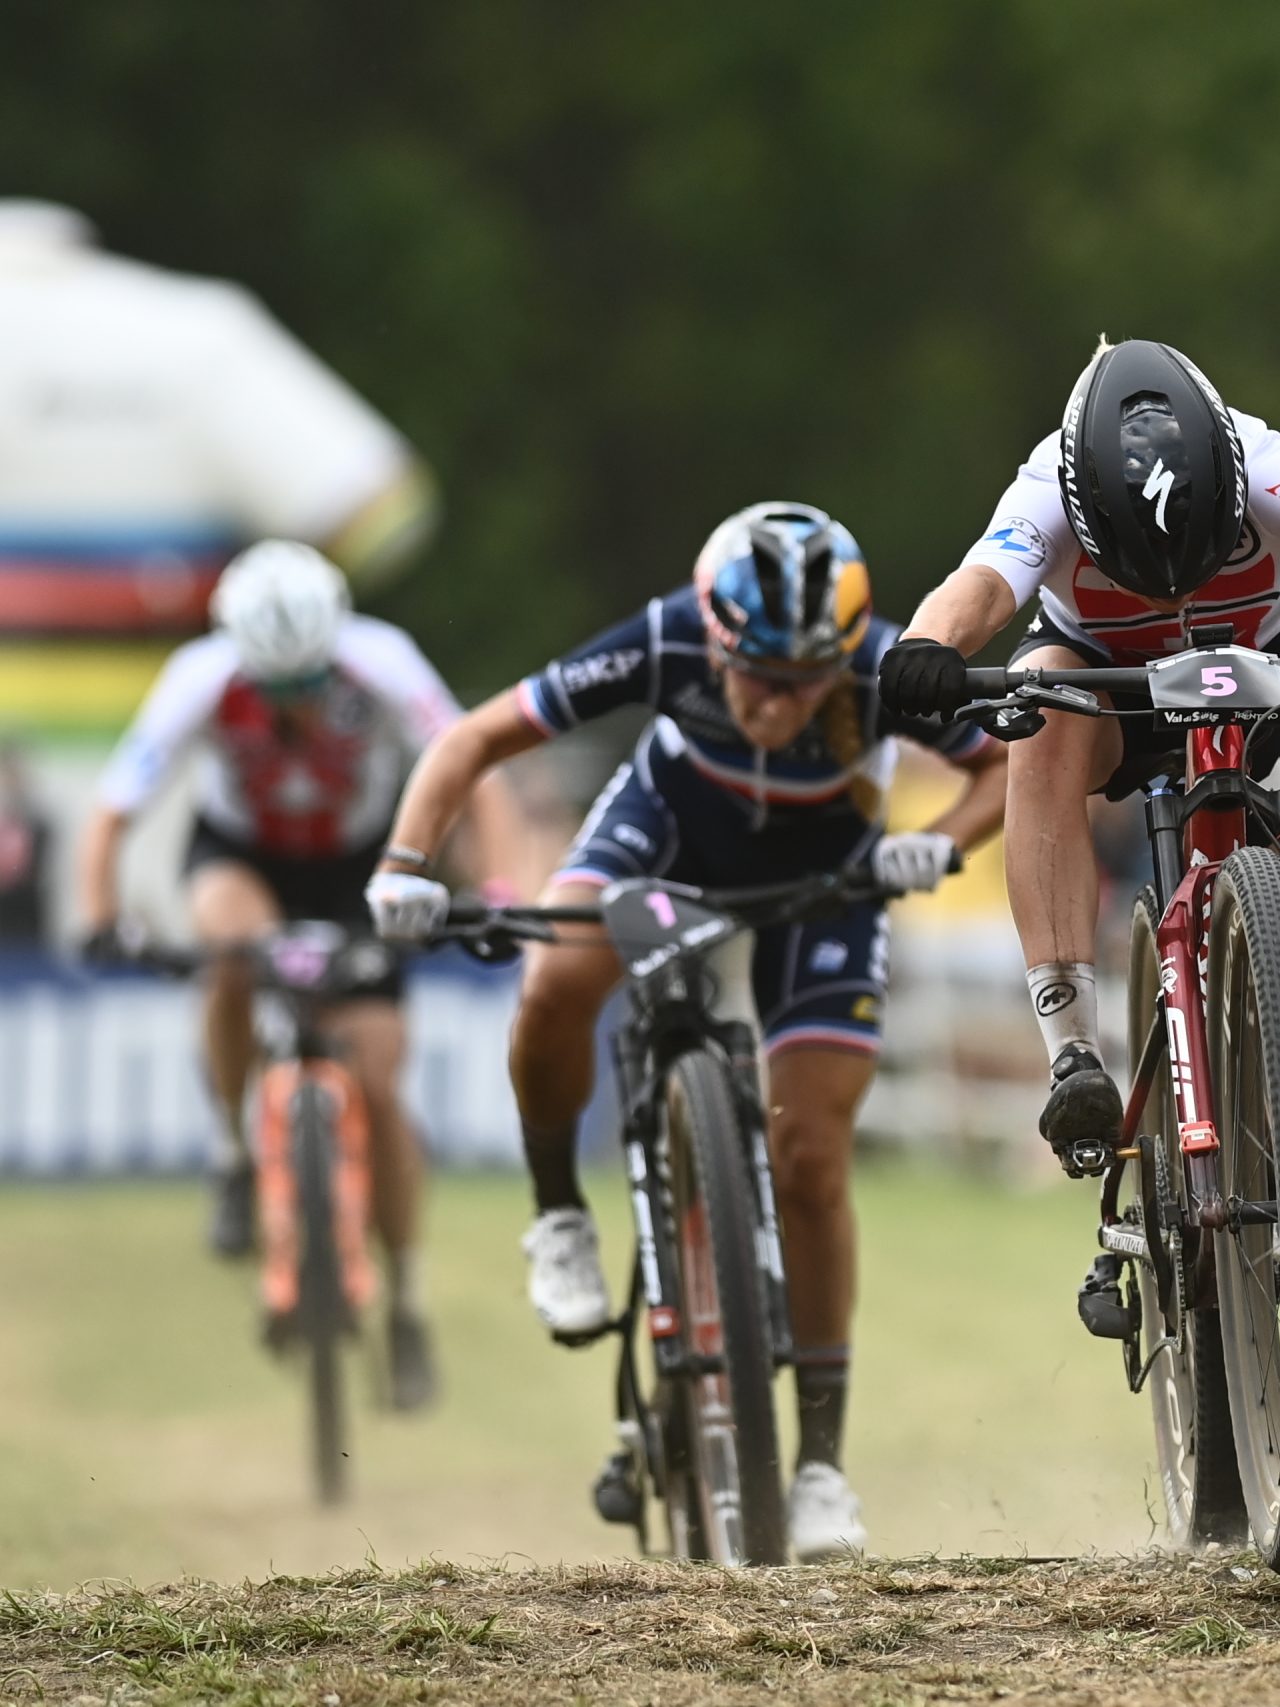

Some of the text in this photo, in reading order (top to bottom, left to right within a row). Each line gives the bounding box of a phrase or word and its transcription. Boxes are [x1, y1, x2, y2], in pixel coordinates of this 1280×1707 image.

[1063, 396, 1101, 555] SPECIALIZED
[1199, 666, 1238, 697] 5
[1164, 711, 1183, 724] Val
[643, 890, 678, 929] 1
